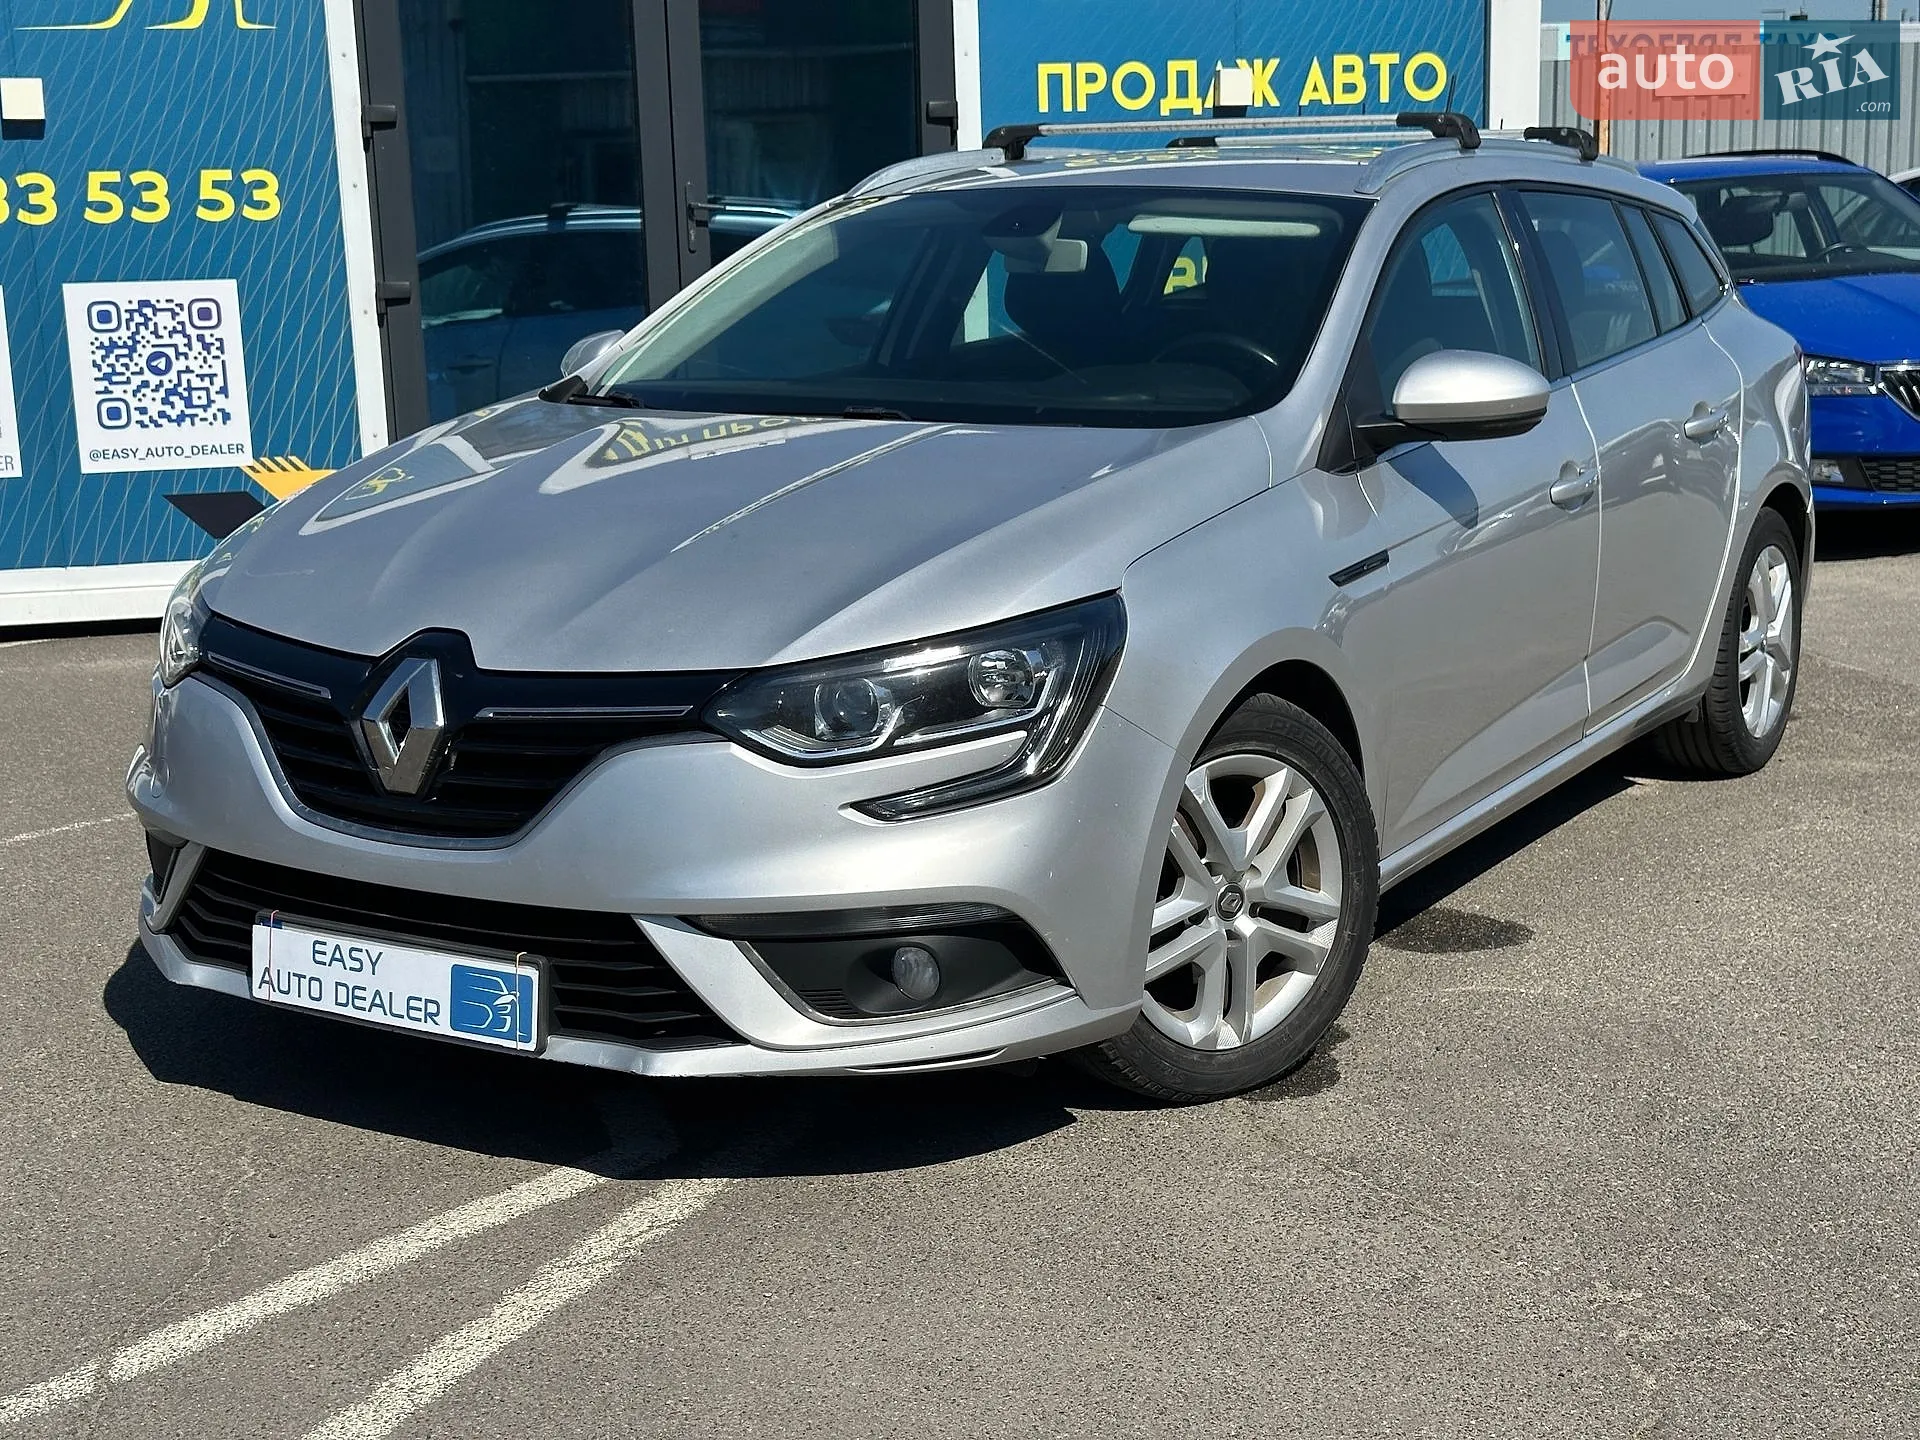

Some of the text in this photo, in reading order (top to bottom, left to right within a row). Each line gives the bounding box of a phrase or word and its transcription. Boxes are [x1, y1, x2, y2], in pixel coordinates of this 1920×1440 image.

[1299, 51, 1448, 106] АВТО
[83, 169, 171, 225] 53
[195, 168, 281, 222] 53
[88, 442, 246, 463] @EASY_AUTO_DEALER
[311, 939, 384, 976] EASY
[258, 966, 441, 1026] AUTO DEALER
